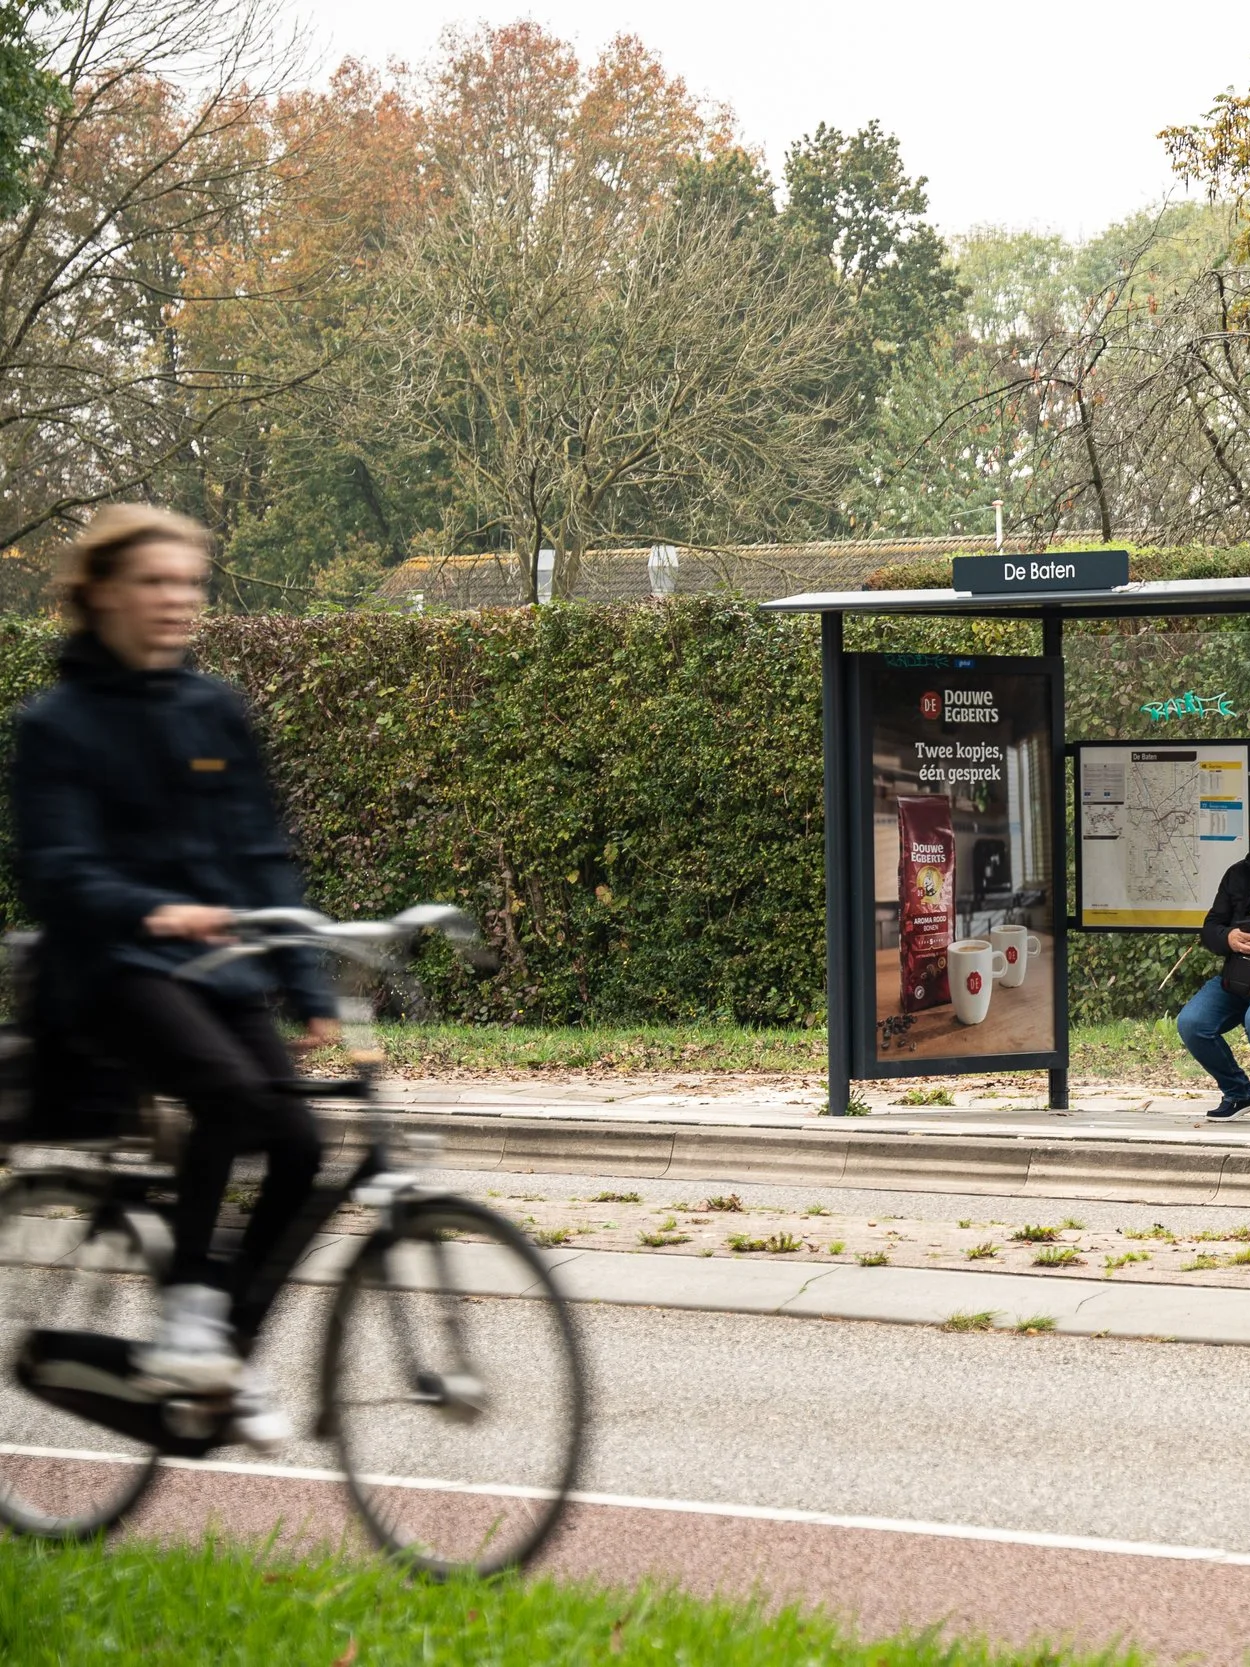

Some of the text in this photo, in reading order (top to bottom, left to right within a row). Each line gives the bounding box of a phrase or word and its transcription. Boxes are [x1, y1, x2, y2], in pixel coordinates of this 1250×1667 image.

[1004, 561, 1076, 581] De Baten
[944, 707, 999, 723] EGBERTS
[915, 741, 1003, 763] Twee kopjes,
[1133, 753, 1158, 761] De Baten
[919, 764, 1001, 785] één gesprek
[911, 852, 946, 863] EGBERTS
[914, 917, 933, 925] AROMA
